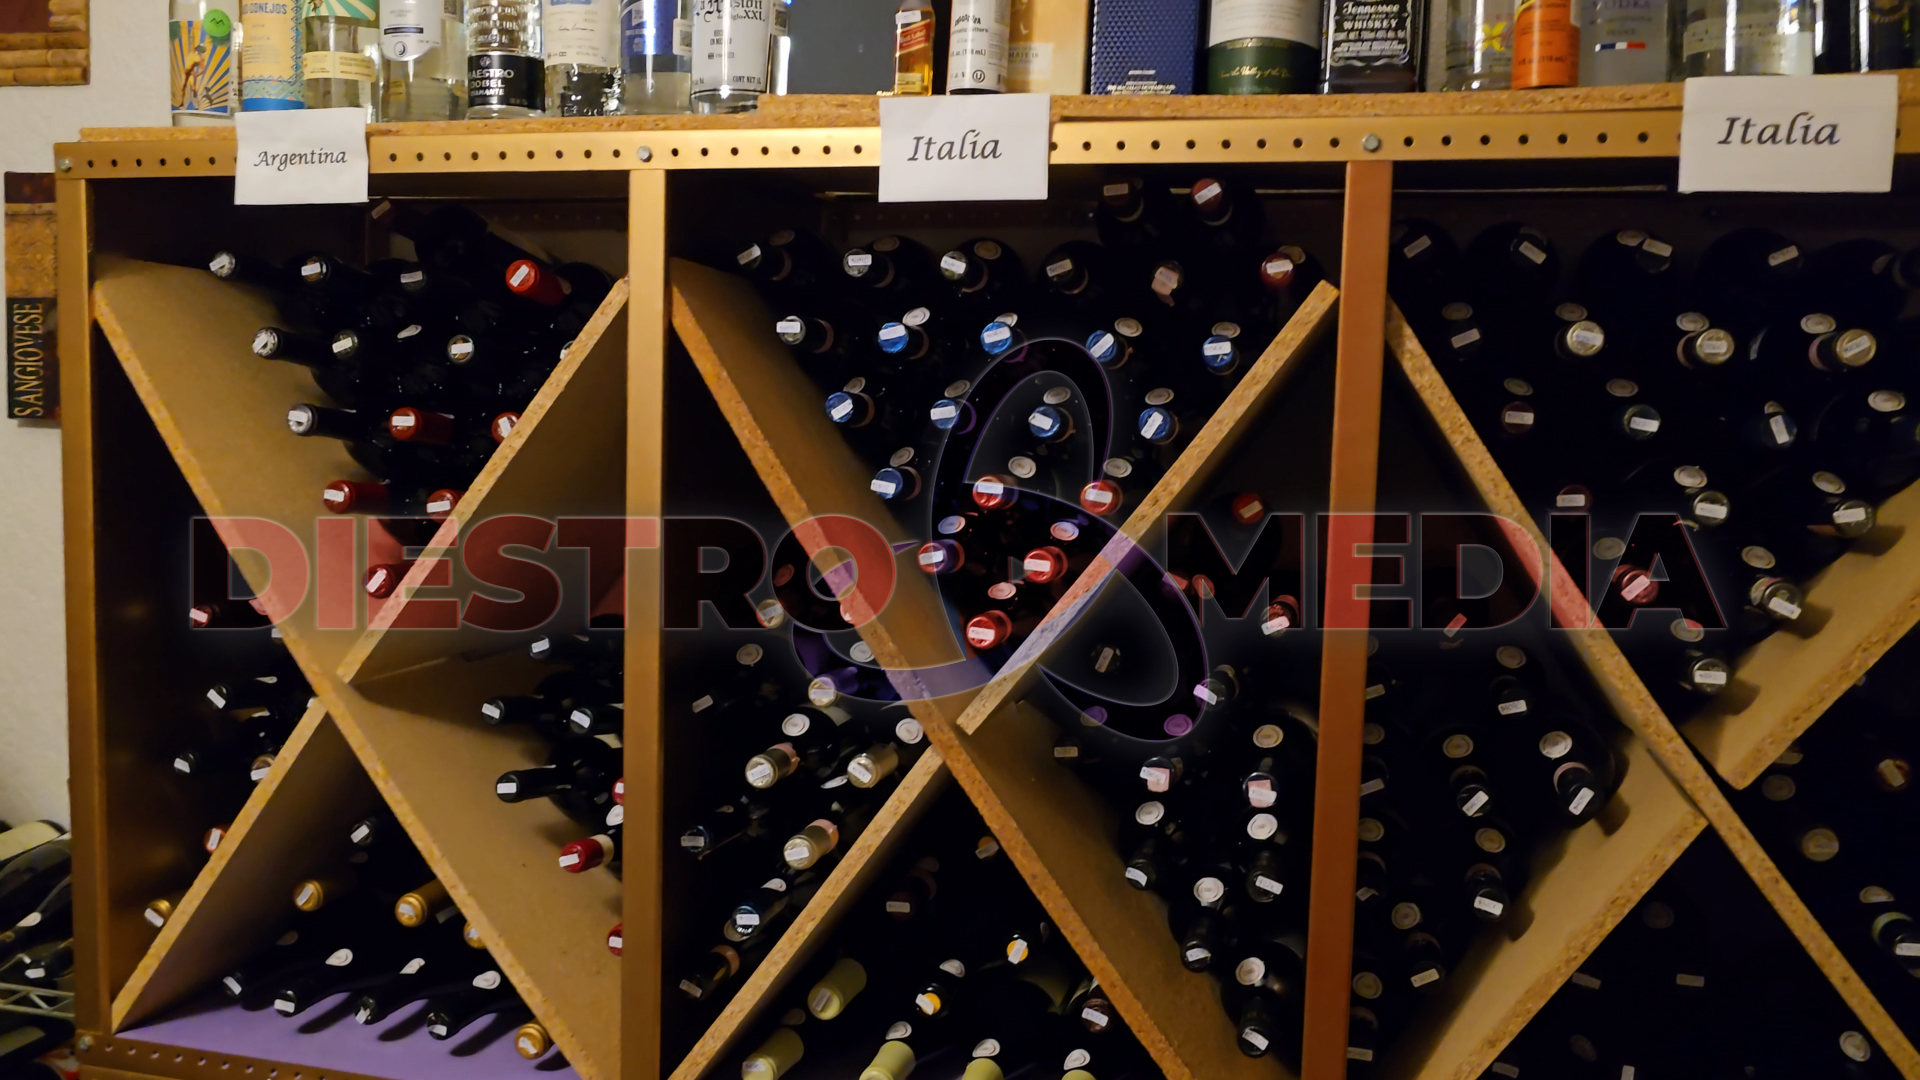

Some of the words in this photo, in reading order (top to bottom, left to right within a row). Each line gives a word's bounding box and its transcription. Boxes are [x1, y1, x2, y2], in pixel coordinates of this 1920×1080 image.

[1343, 2, 1399, 15] Tennessee
[1343, 18, 1398, 30] WHISKEY
[254, 148, 348, 172] Argentina
[13, 303, 43, 417] SANGIOVESE
